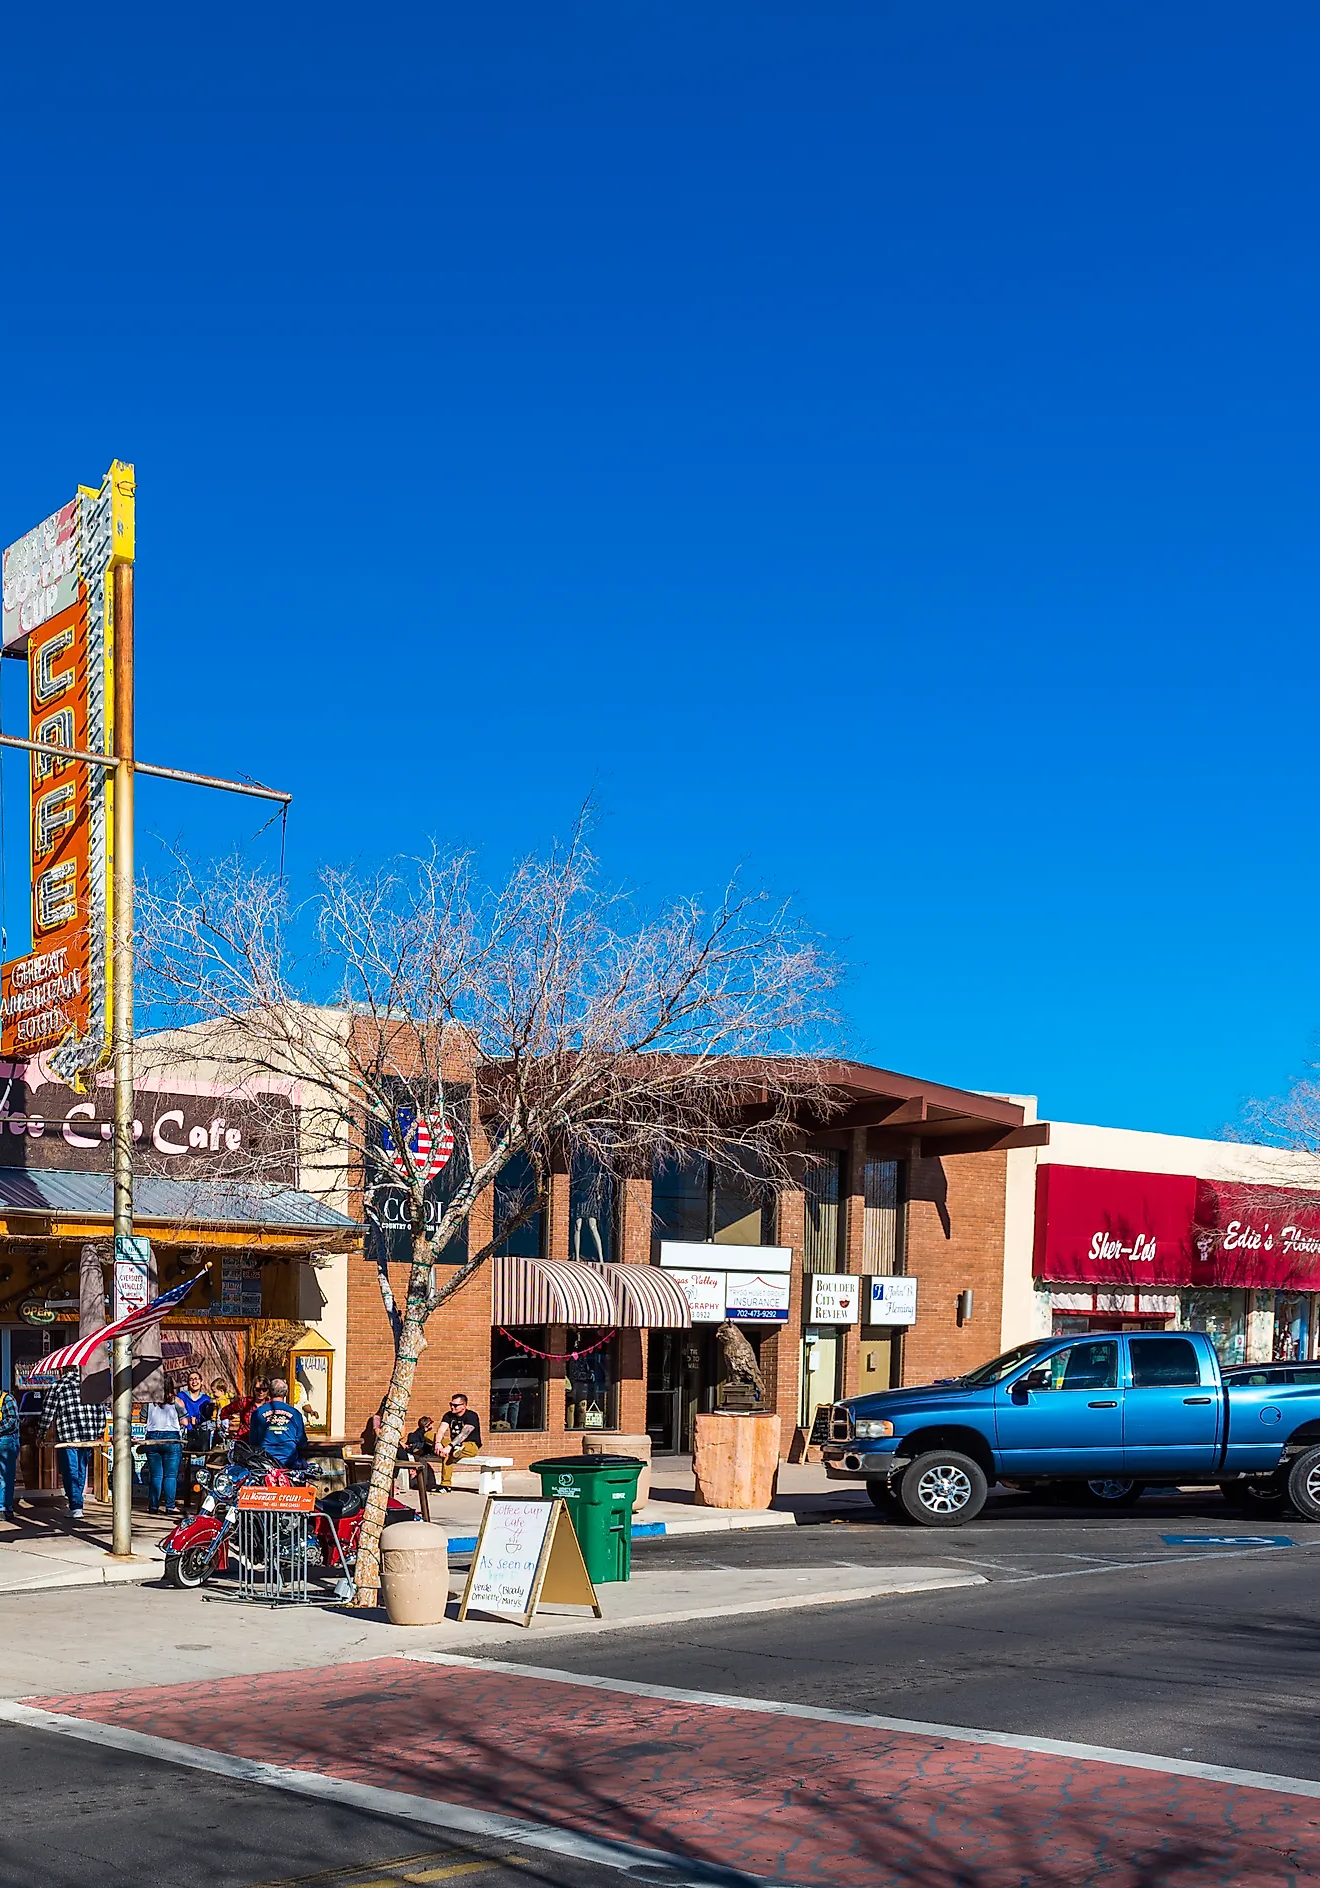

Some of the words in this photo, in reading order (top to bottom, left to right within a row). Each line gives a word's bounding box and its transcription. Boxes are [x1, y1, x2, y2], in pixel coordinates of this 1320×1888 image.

[3, 535, 77, 612] COFFEE
[20, 583, 59, 631] CUP
[32, 624, 78, 931] CAFE
[11, 946, 68, 988] GREAT
[0, 967, 82, 1017] AMERICAN
[17, 1007, 64, 1040] FOOD
[152, 1109, 242, 1156] Cafe
[1223, 1220, 1274, 1251] Edie's
[120, 1274, 144, 1283] OVERSIZED
[690, 1275, 718, 1288] Valley
[121, 1282, 143, 1290] VEHICLES
[816, 1280, 855, 1293] BOULDER
[815, 1293, 835, 1306] CITY
[885, 1285, 903, 1301] John
[733, 1298, 780, 1308] INSURANCE
[22, 1306, 53, 1317] OPEN
[736, 1310, 777, 1318] 702-473-9292
[815, 1306, 848, 1319] REVIEW
[885, 1301, 914, 1319] Fleming
[493, 1503, 520, 1516] Coffee
[523, 1503, 543, 1520] Cup
[504, 1516, 526, 1528] Cafe
[479, 1555, 493, 1570] As
[496, 1558, 521, 1570] seen
[523, 1561, 535, 1571] on
[473, 1583, 492, 1592] Verde
[502, 1585, 525, 1598] Bloody
[501, 1597, 522, 1608] Mary's
